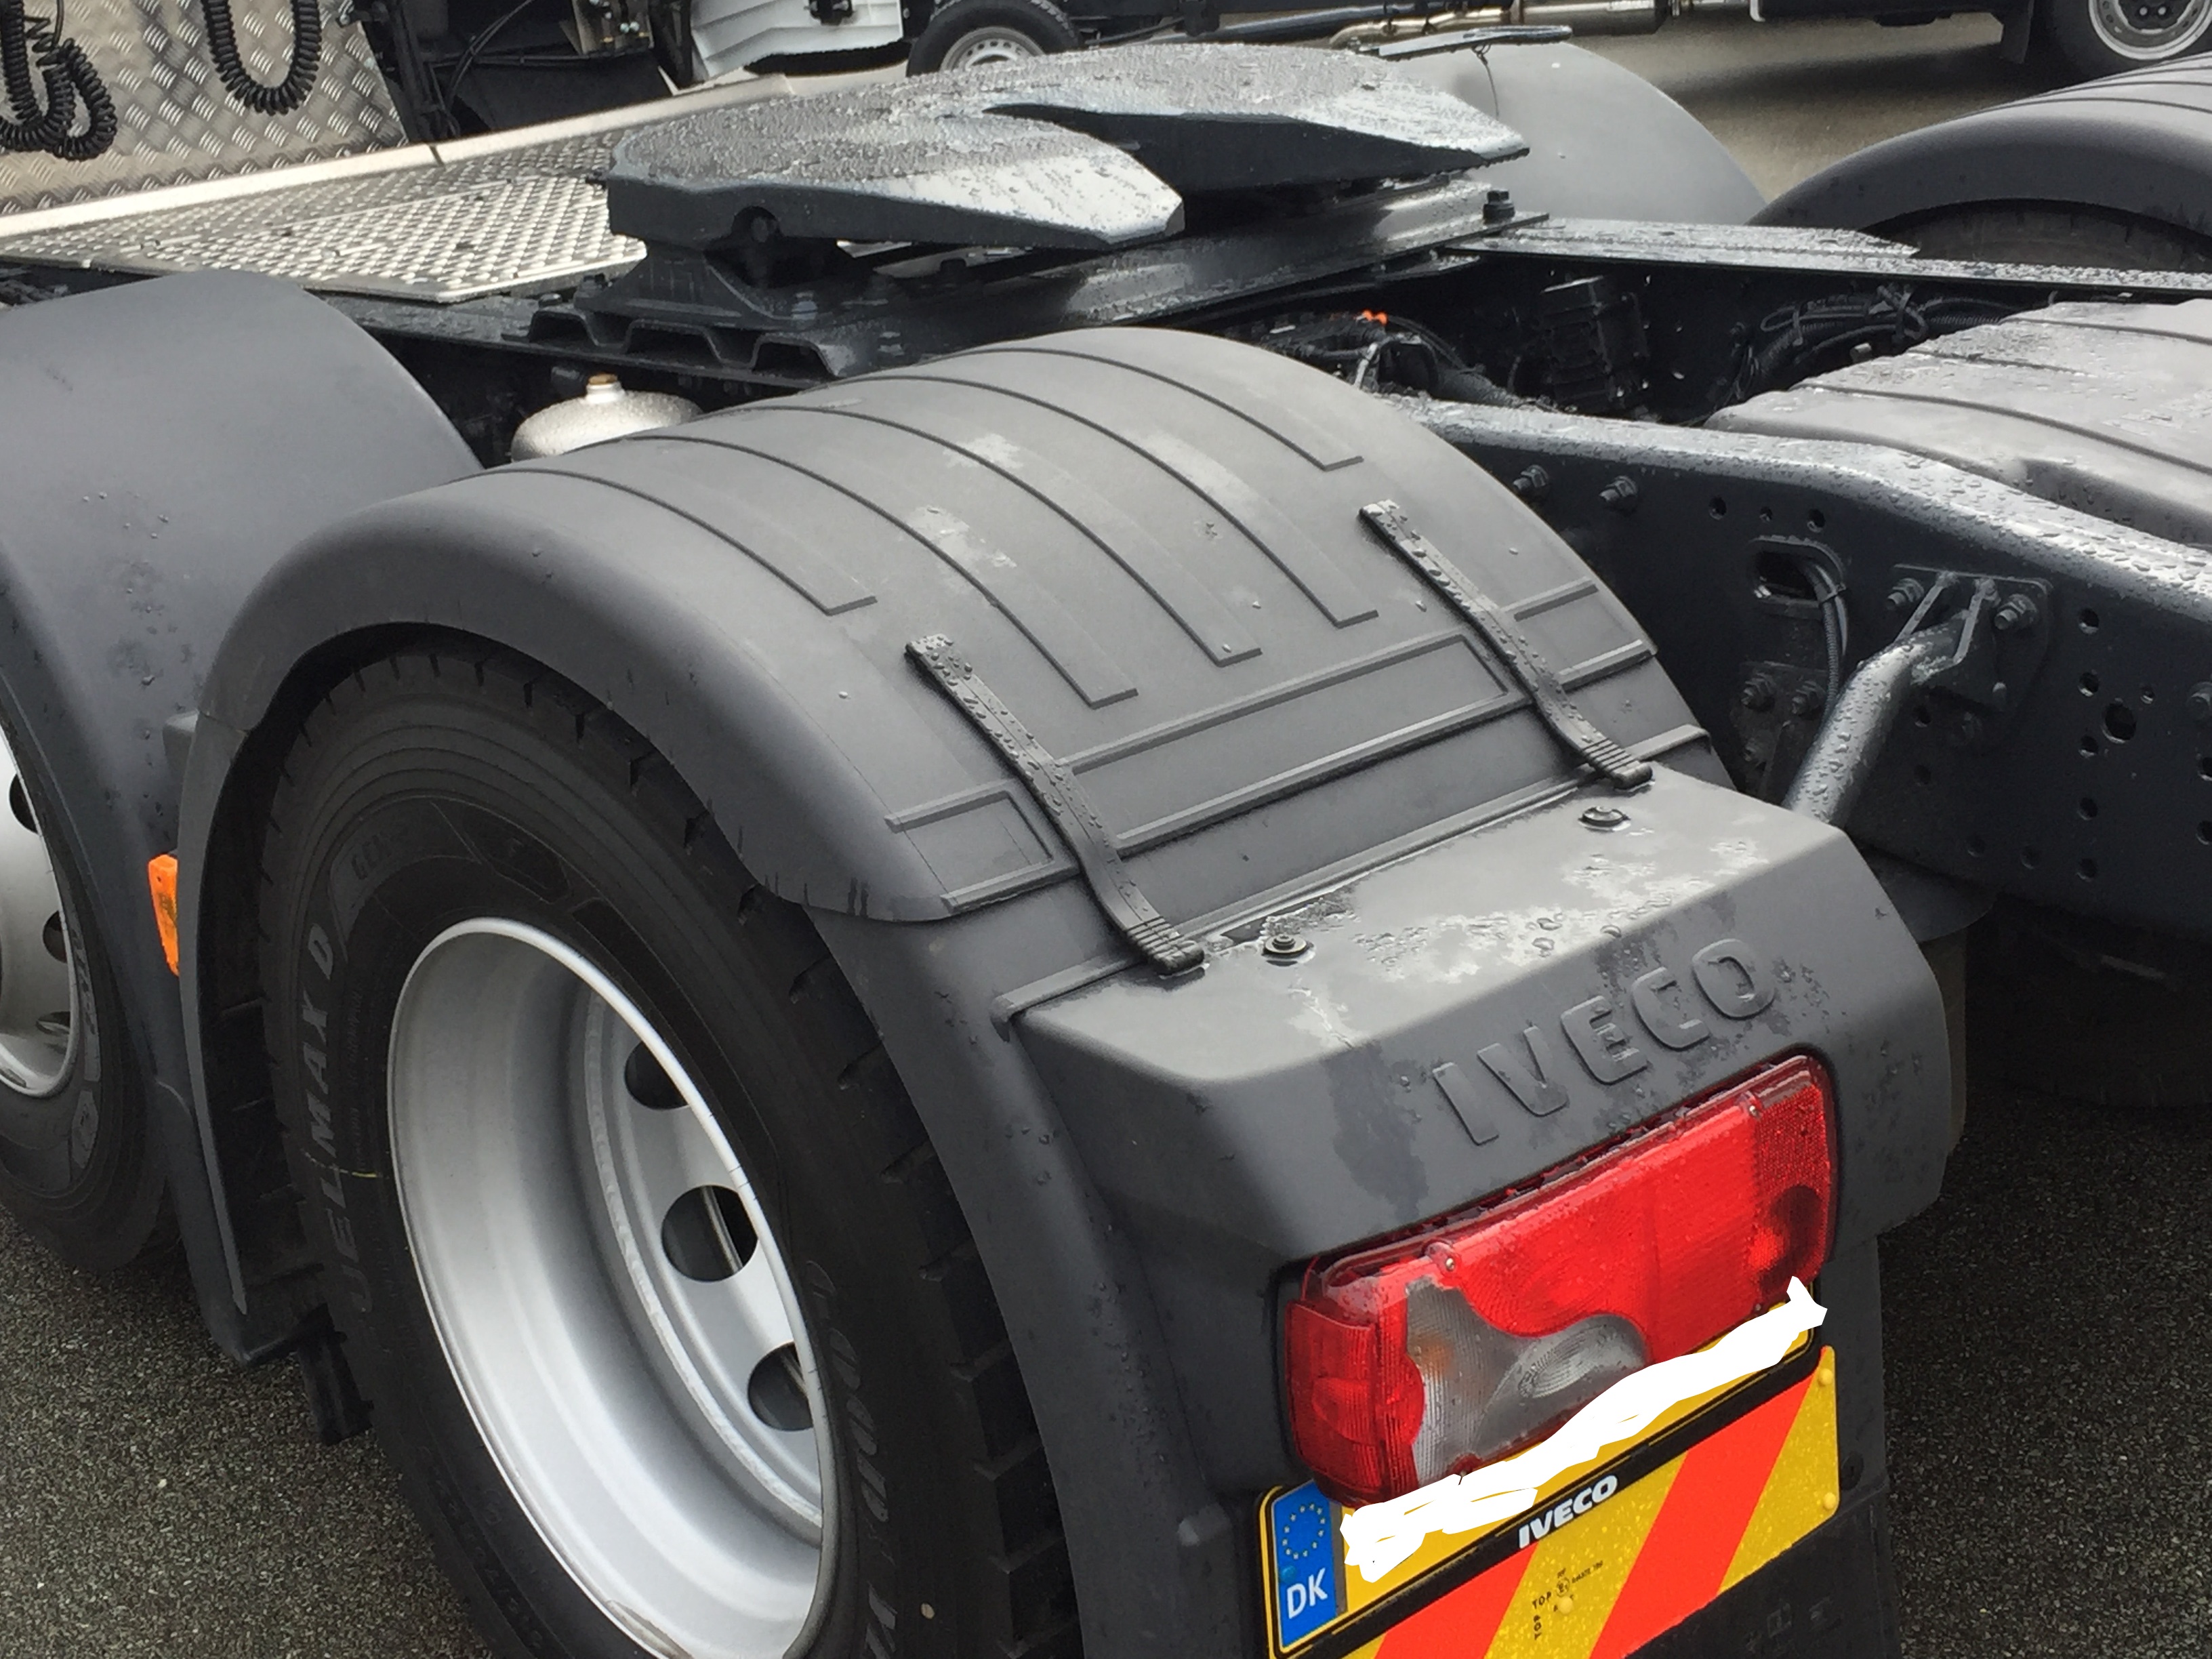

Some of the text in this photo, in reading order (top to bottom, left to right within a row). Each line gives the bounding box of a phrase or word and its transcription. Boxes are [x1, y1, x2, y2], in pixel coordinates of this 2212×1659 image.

[1431, 938, 1776, 1146] IVECO
[300, 989, 381, 1332] UELMAX
[1519, 1475, 1618, 1549] IVECO
[1286, 1568, 1328, 1620] DK
[1532, 1591, 1552, 1610] TOP
